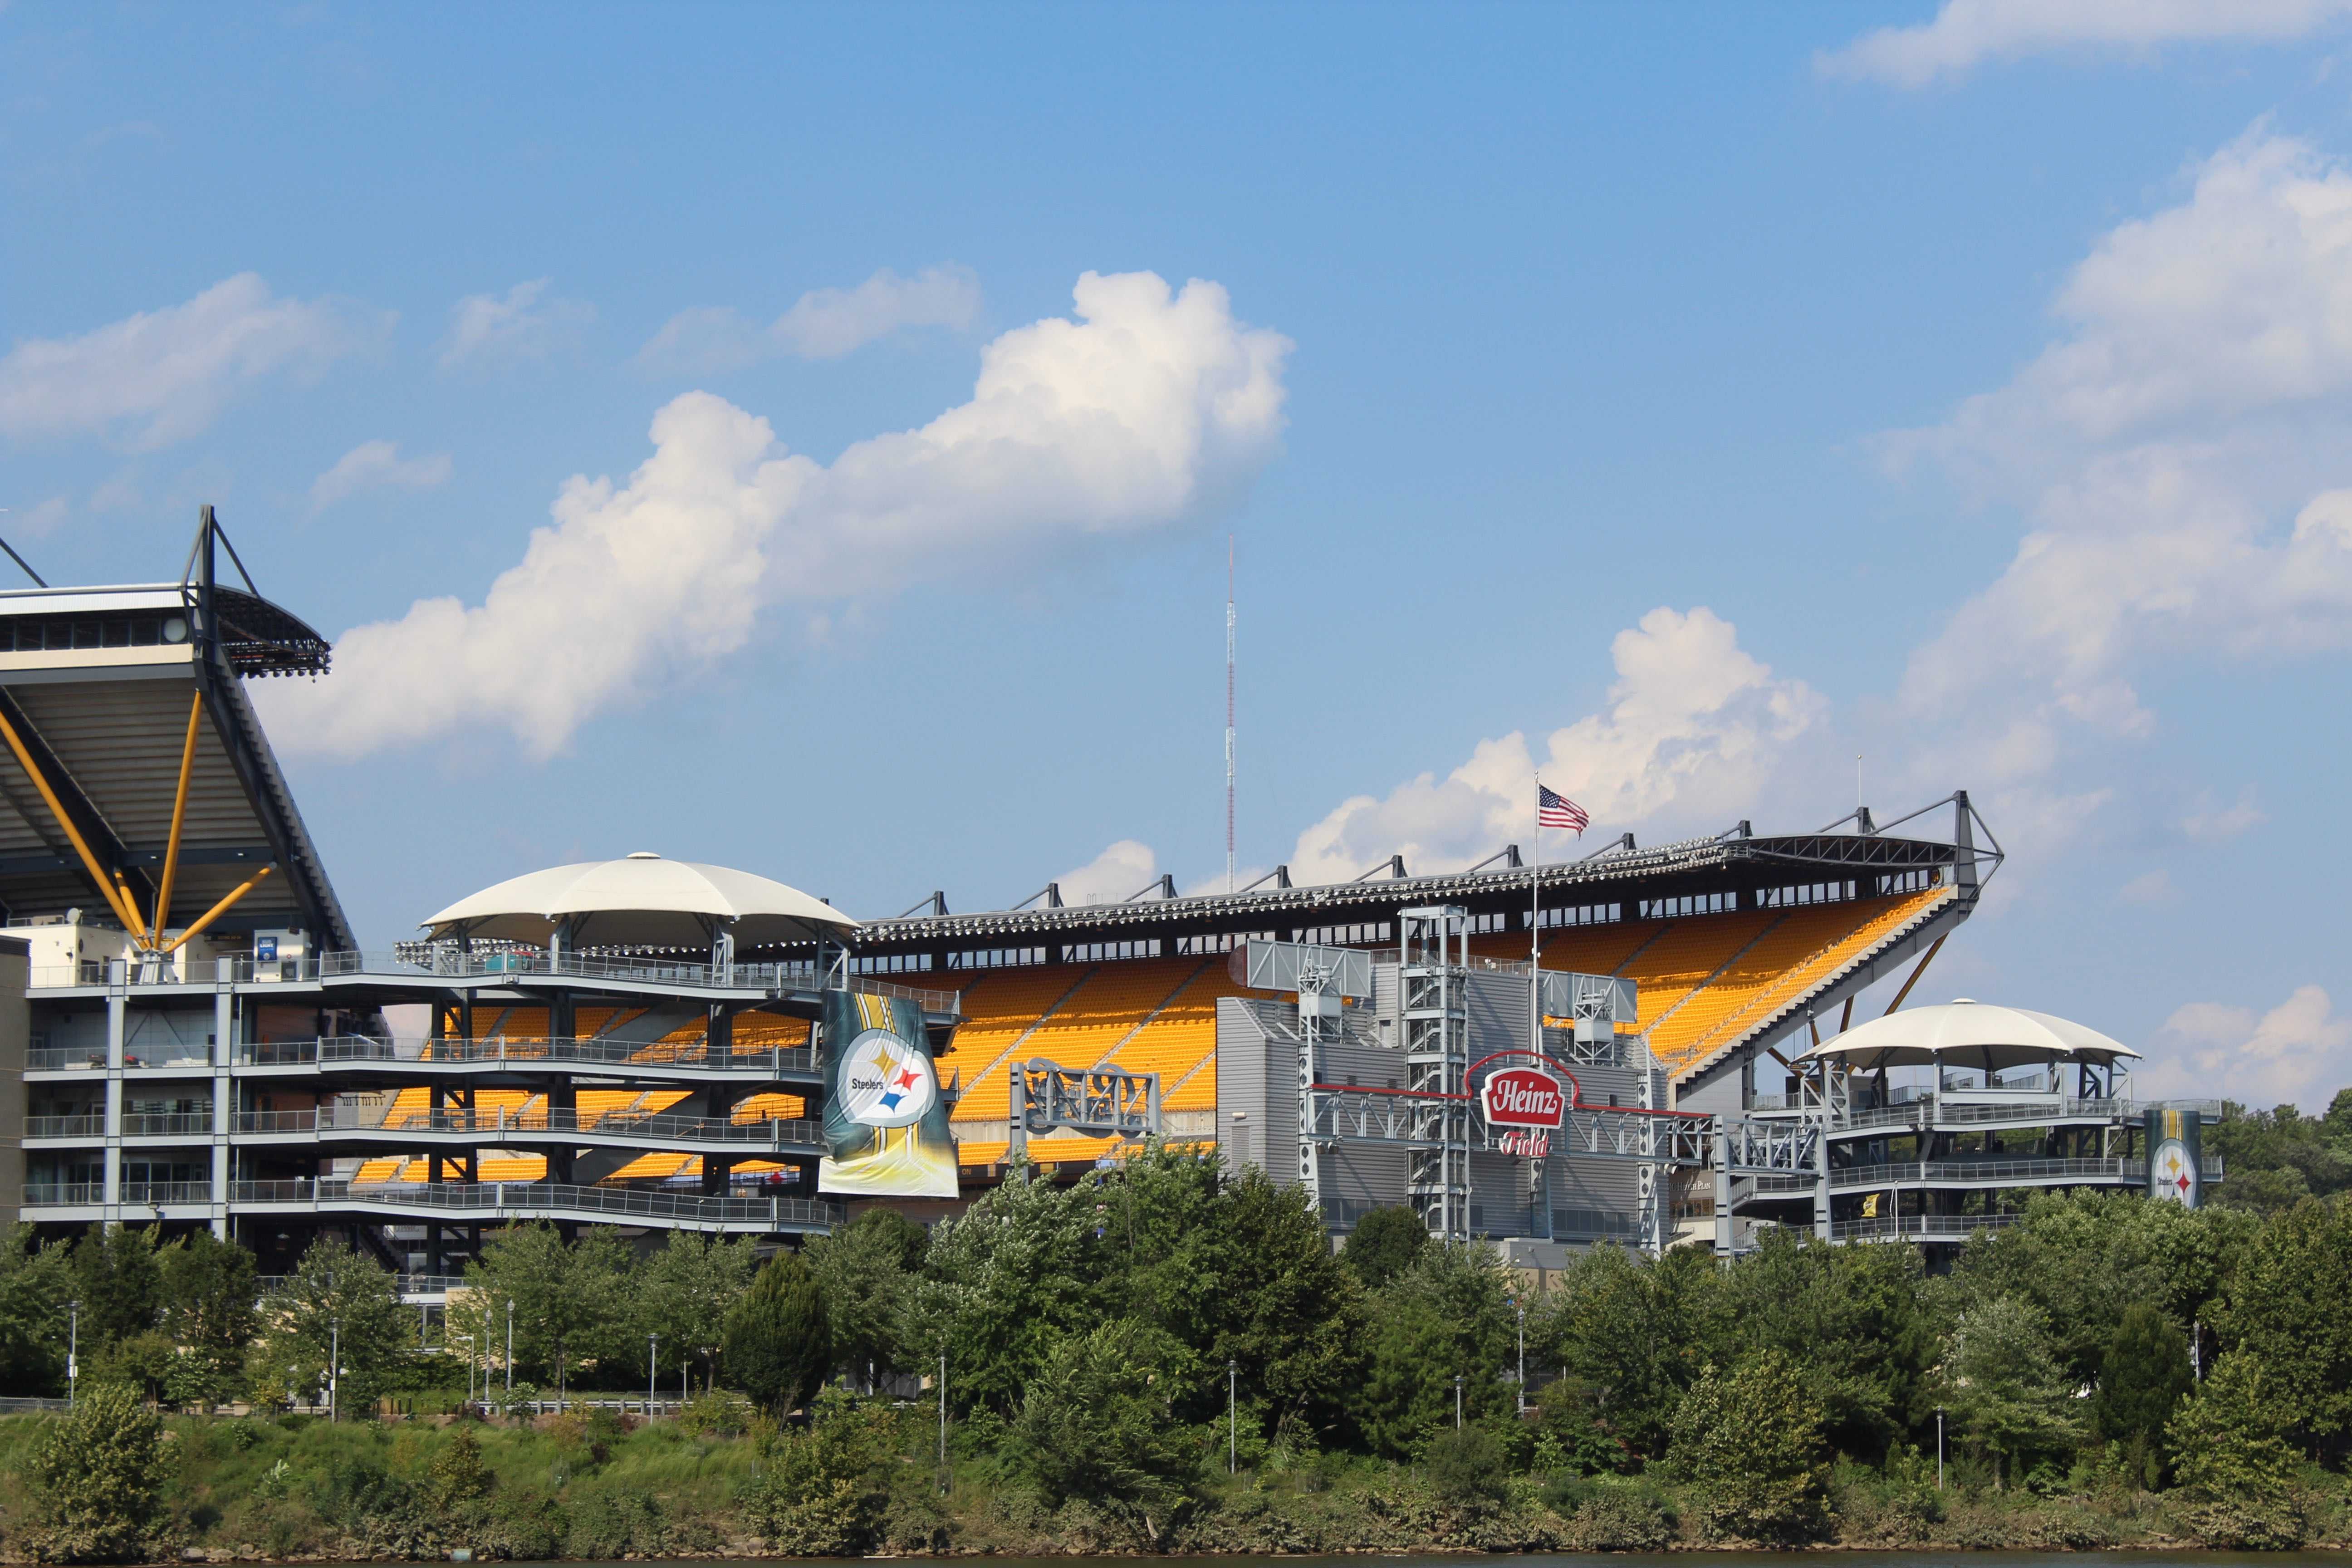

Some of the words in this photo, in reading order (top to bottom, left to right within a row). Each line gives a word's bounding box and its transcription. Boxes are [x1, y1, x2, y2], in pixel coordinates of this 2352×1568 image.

[852, 1078, 884, 1090] Steelers
[1492, 1080, 1558, 1114] Heinz
[1501, 1131, 1549, 1157] Field
